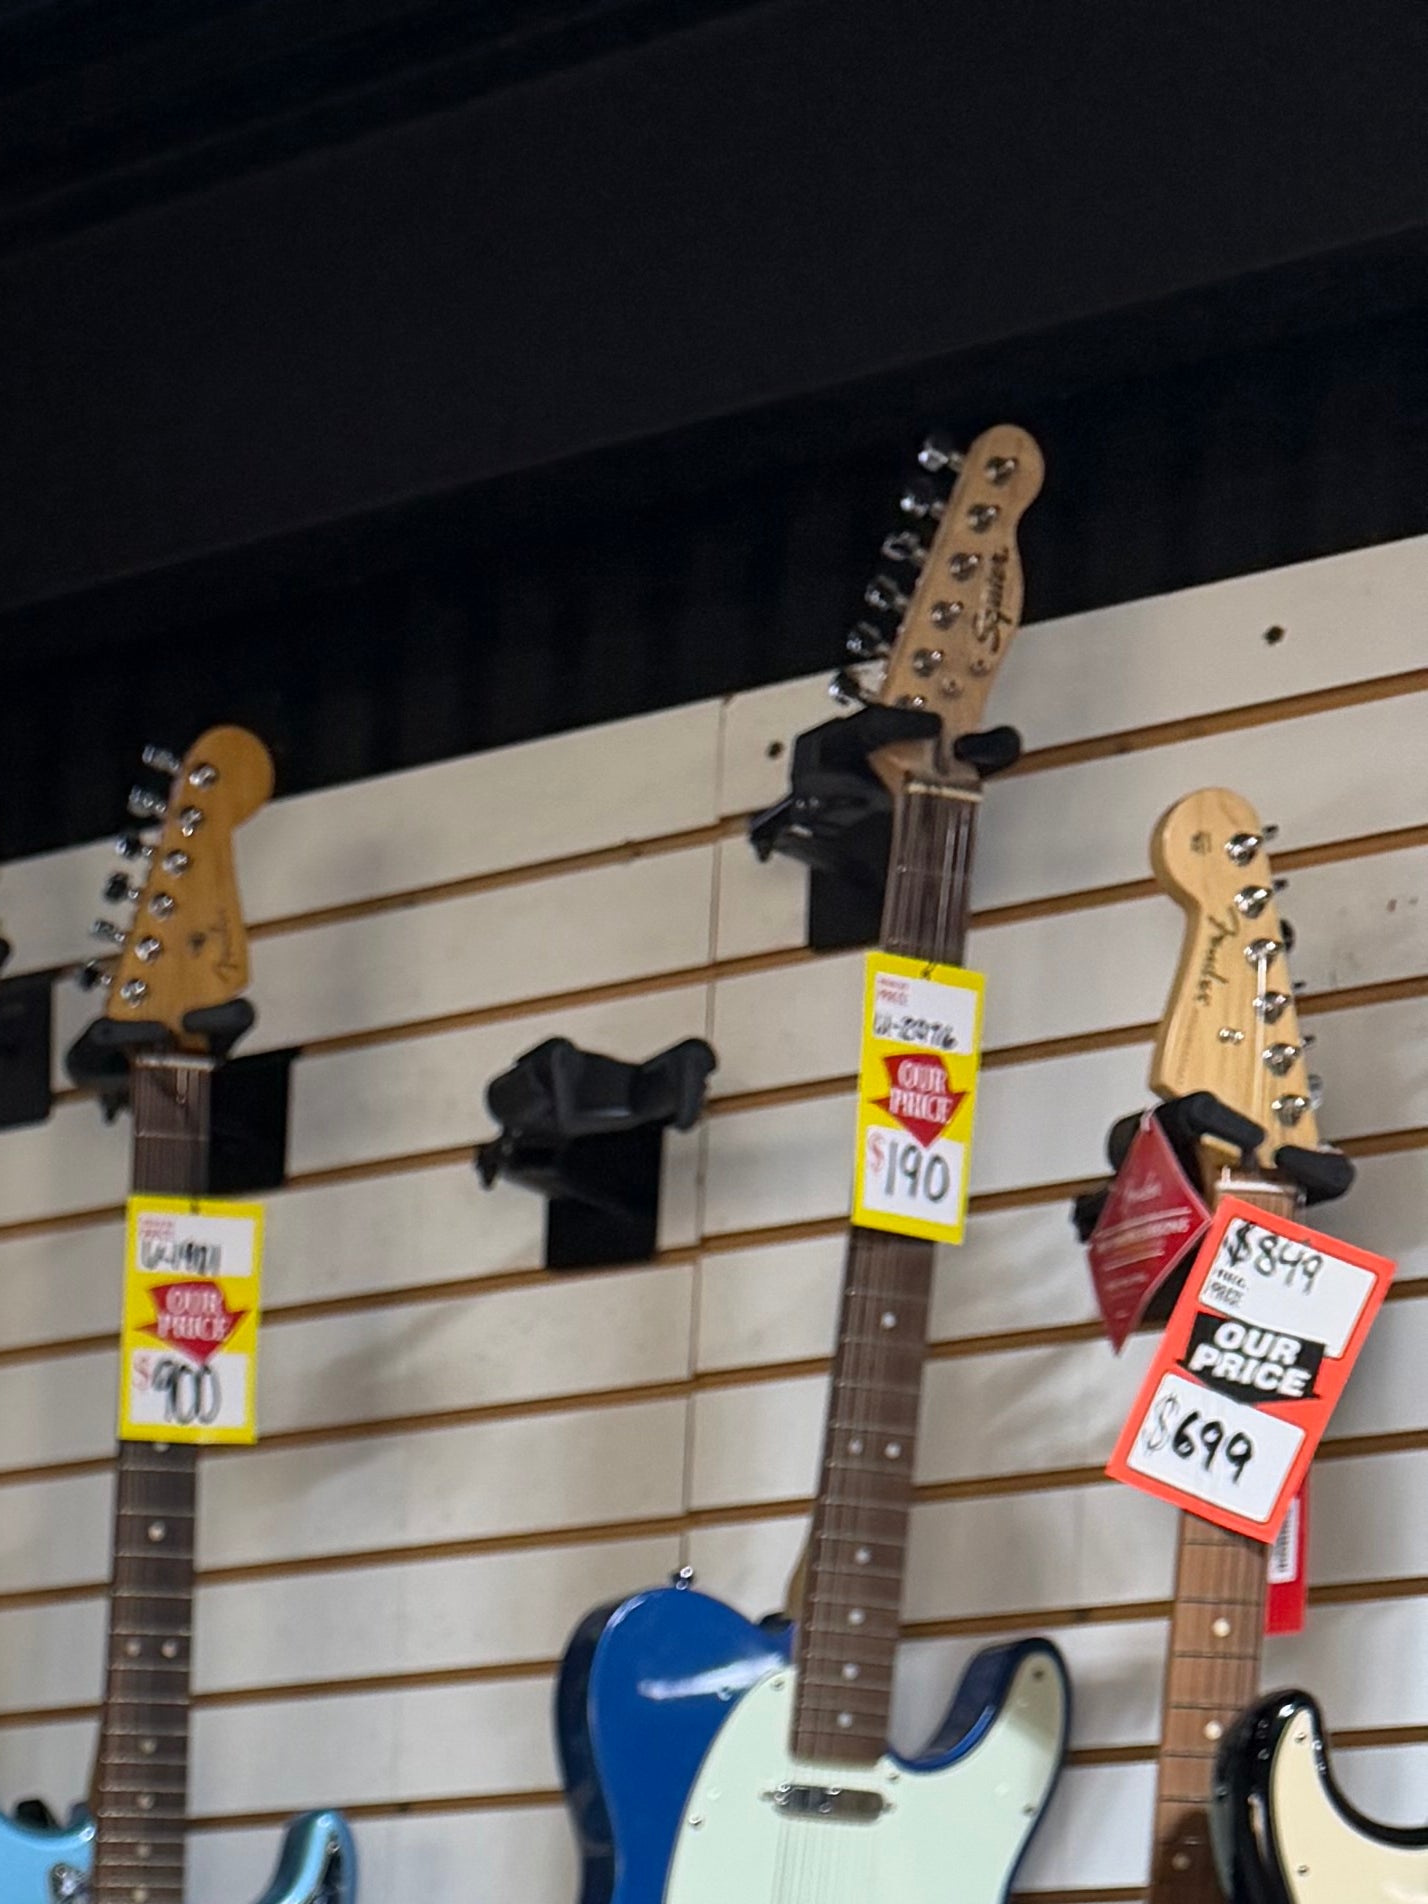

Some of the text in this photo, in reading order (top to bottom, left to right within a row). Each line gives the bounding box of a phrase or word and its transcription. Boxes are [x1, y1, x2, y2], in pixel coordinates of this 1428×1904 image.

[897, 1058, 948, 1094] OUR
[888, 1086, 954, 1125] PRICE
[1223, 1220, 1325, 1297] $849
[1213, 1320, 1303, 1366] OUR
[1187, 1341, 1313, 1399] PRICE
[1142, 1392, 1254, 1485] $699
